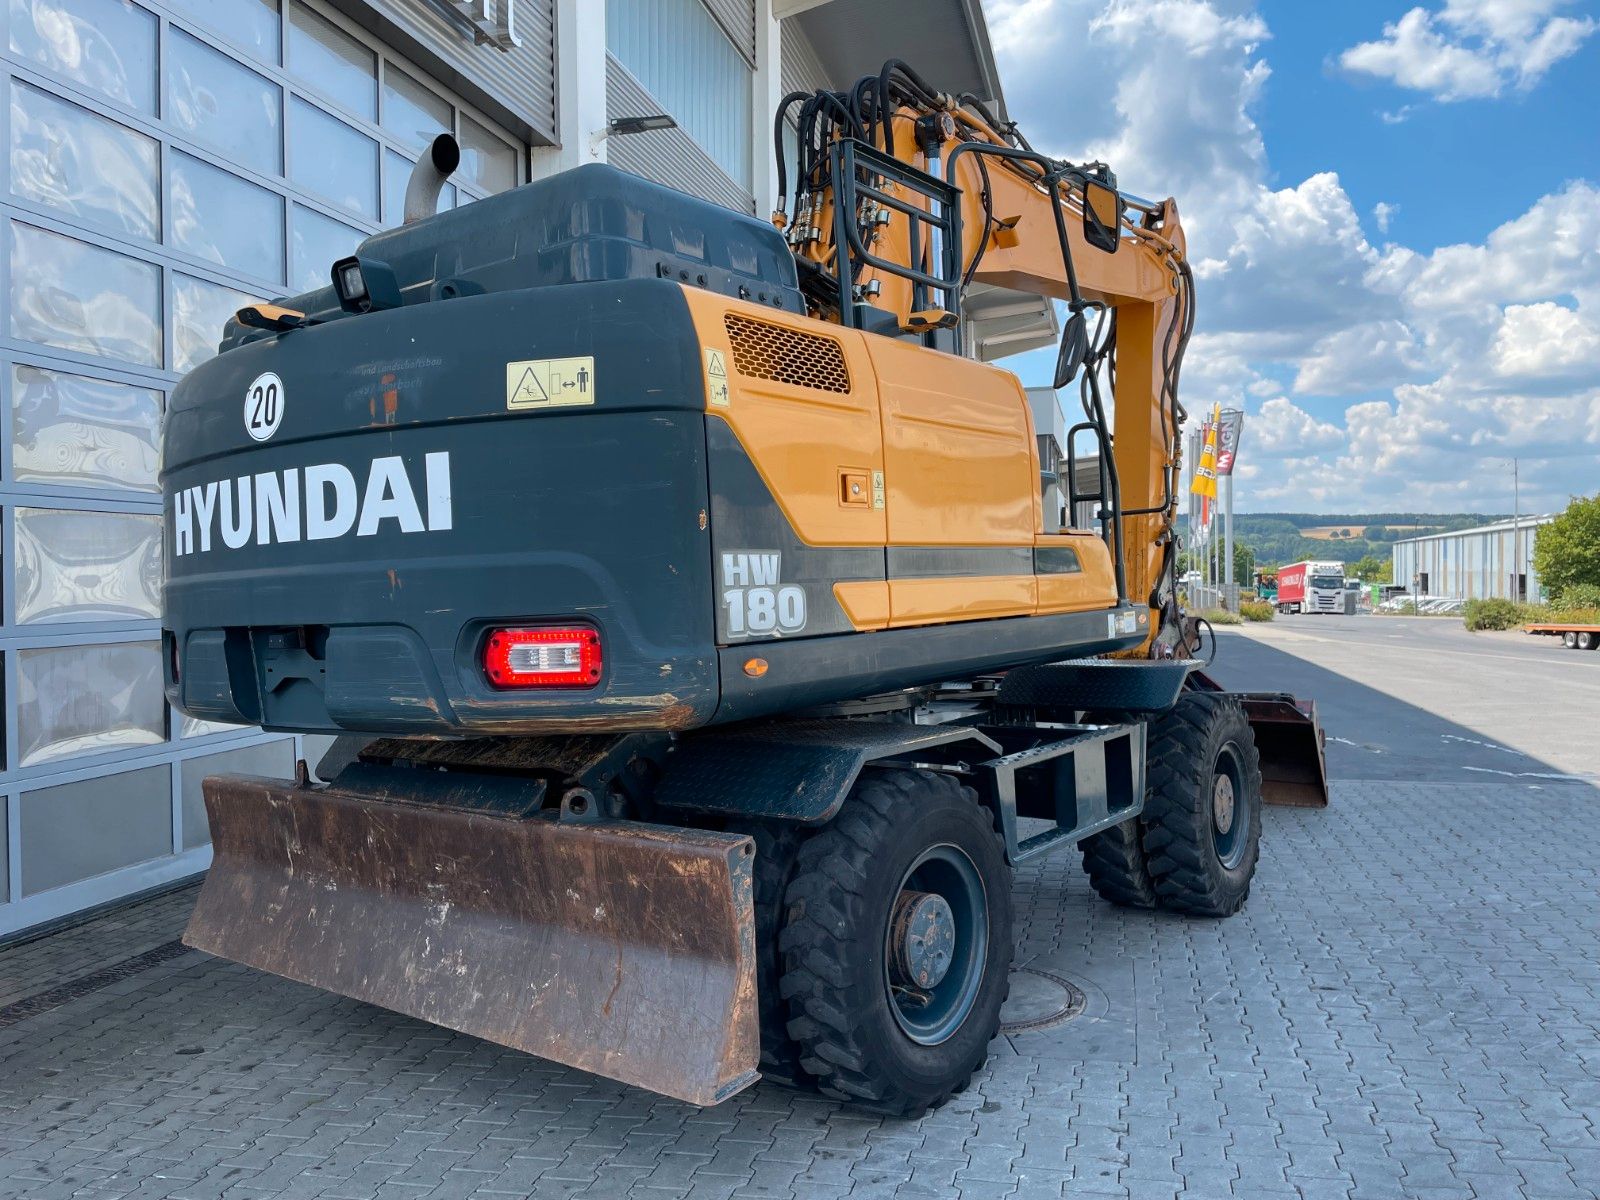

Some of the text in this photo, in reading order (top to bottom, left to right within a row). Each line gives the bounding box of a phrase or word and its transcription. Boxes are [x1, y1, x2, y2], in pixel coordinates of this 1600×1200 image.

[251, 383, 277, 428] 20
[174, 451, 453, 557] HYUNDAI
[722, 553, 779, 586] HW
[722, 586, 806, 634] 180
